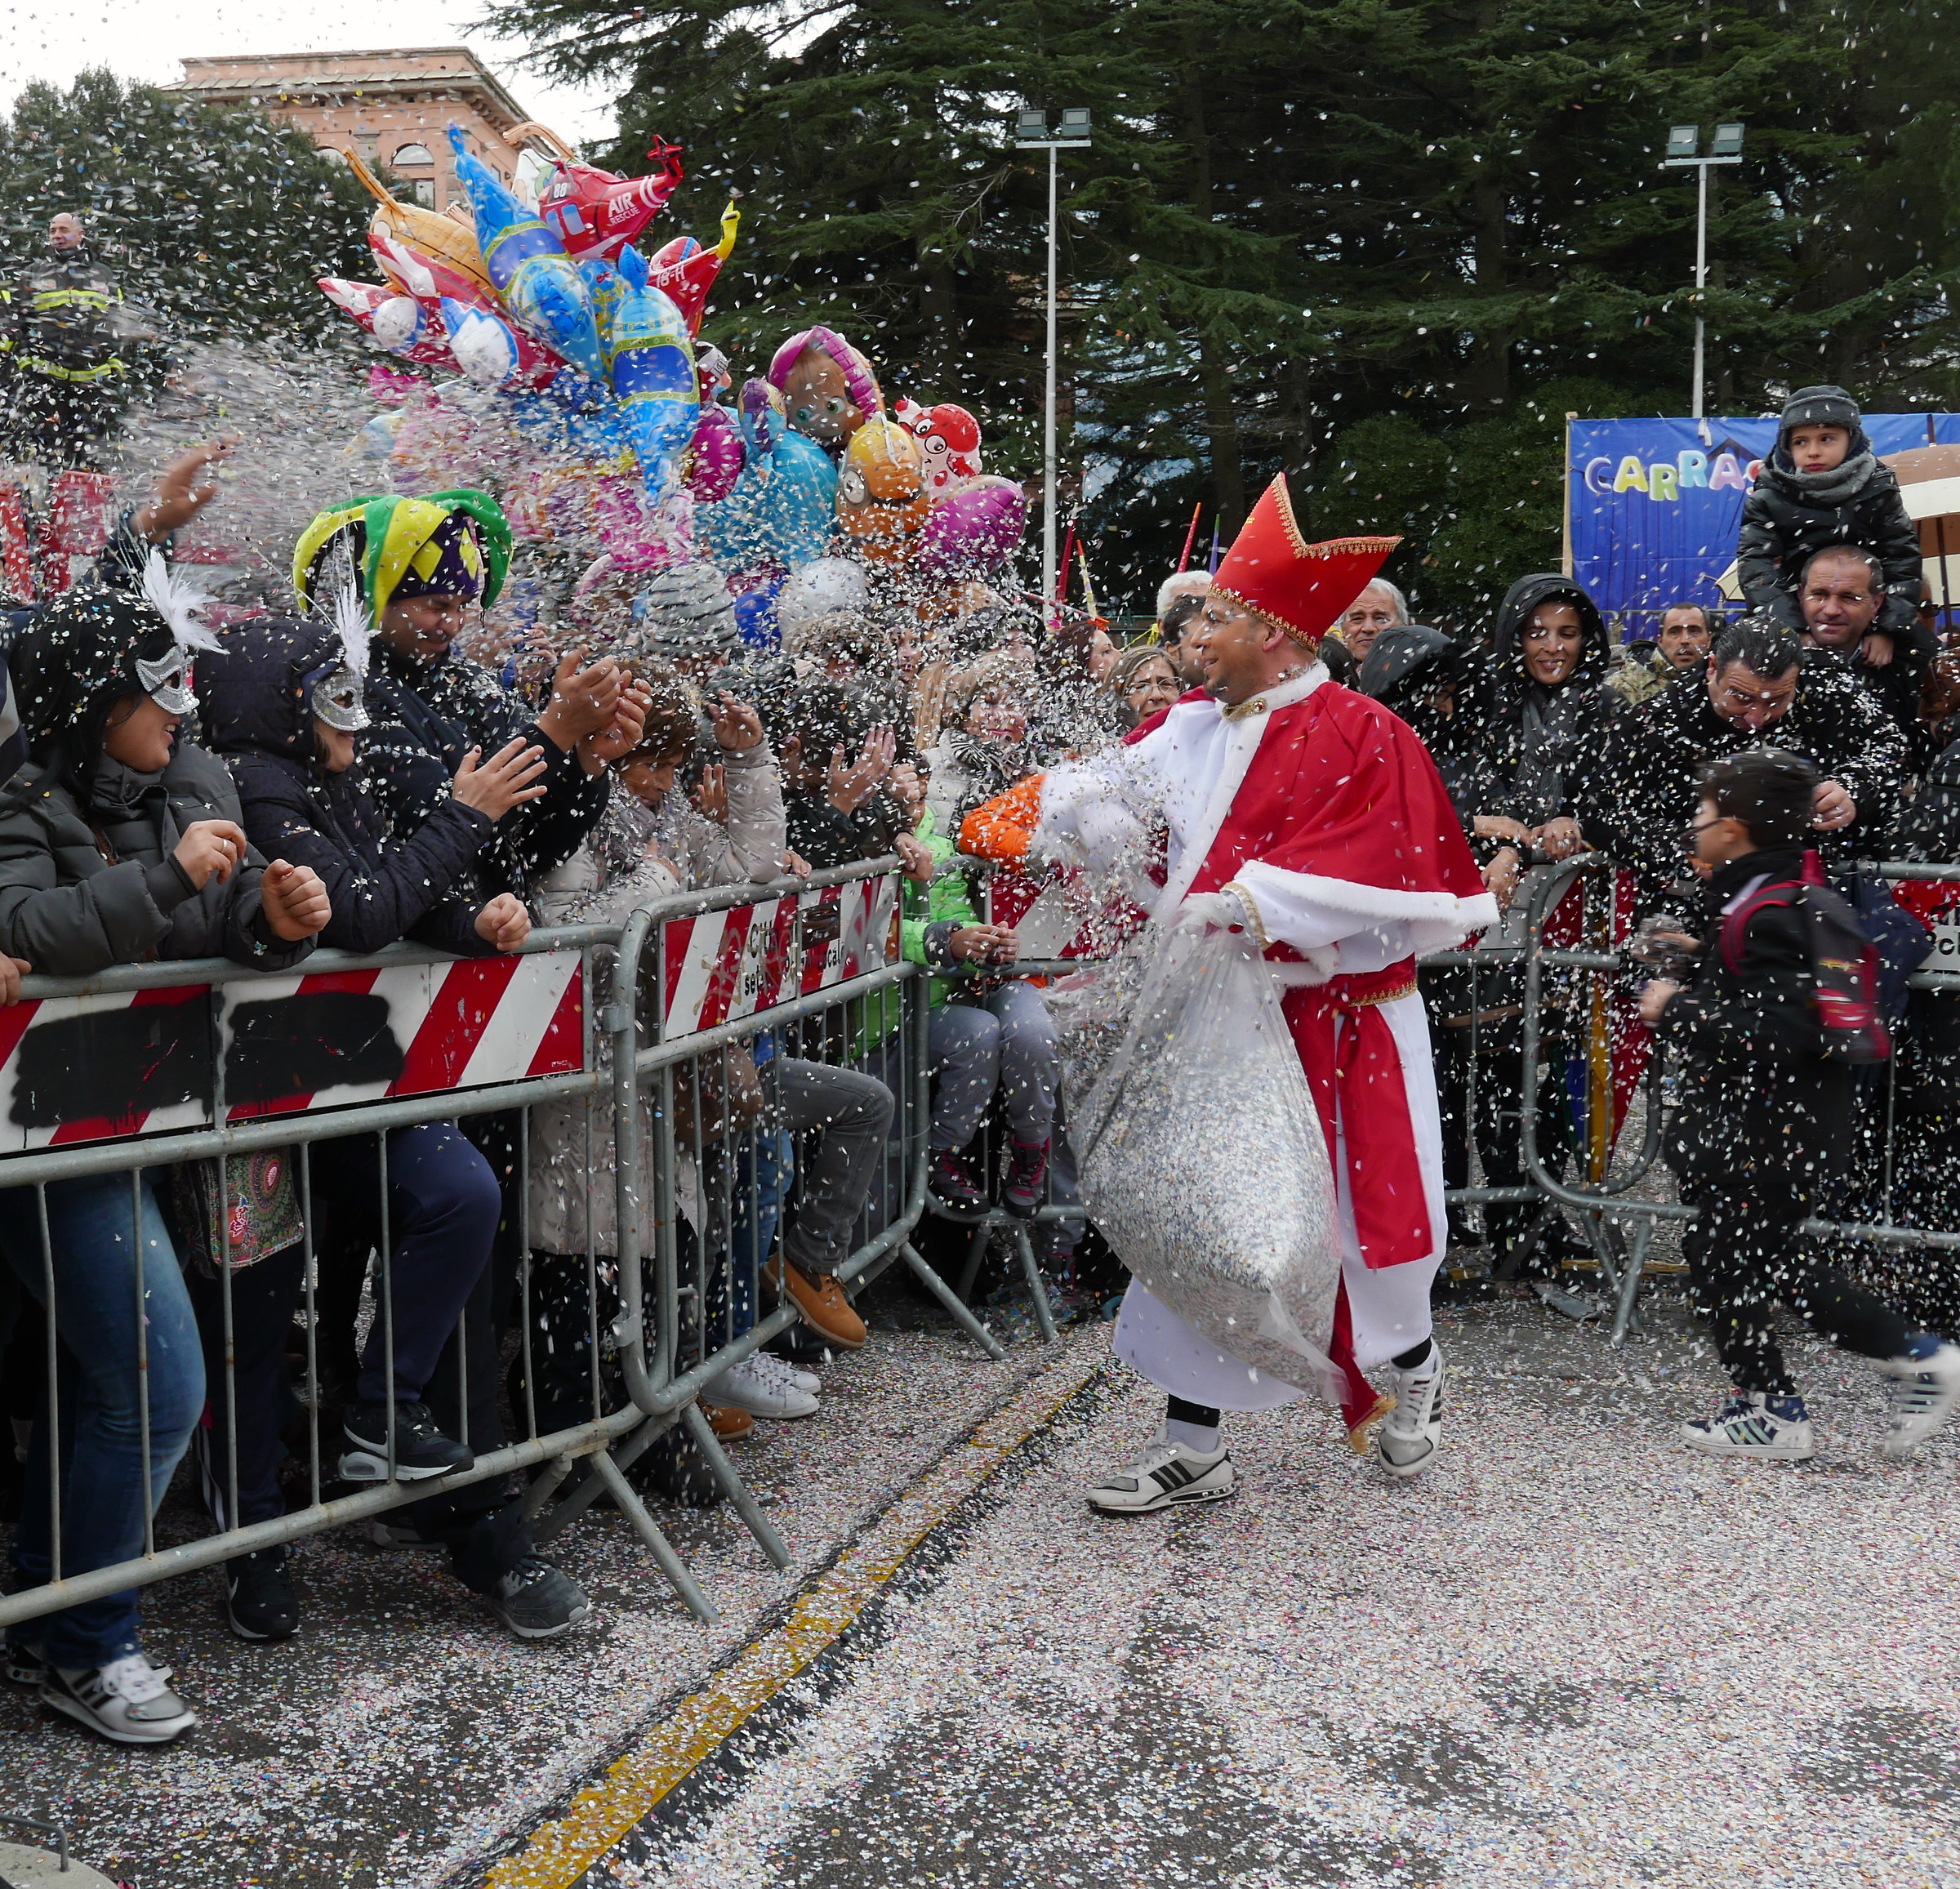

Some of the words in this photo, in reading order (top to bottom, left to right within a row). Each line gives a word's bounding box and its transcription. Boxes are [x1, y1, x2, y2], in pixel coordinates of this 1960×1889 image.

[554, 182, 568, 198] 88
[608, 192, 635, 218] AIR
[609, 207, 640, 225] RESCUE
